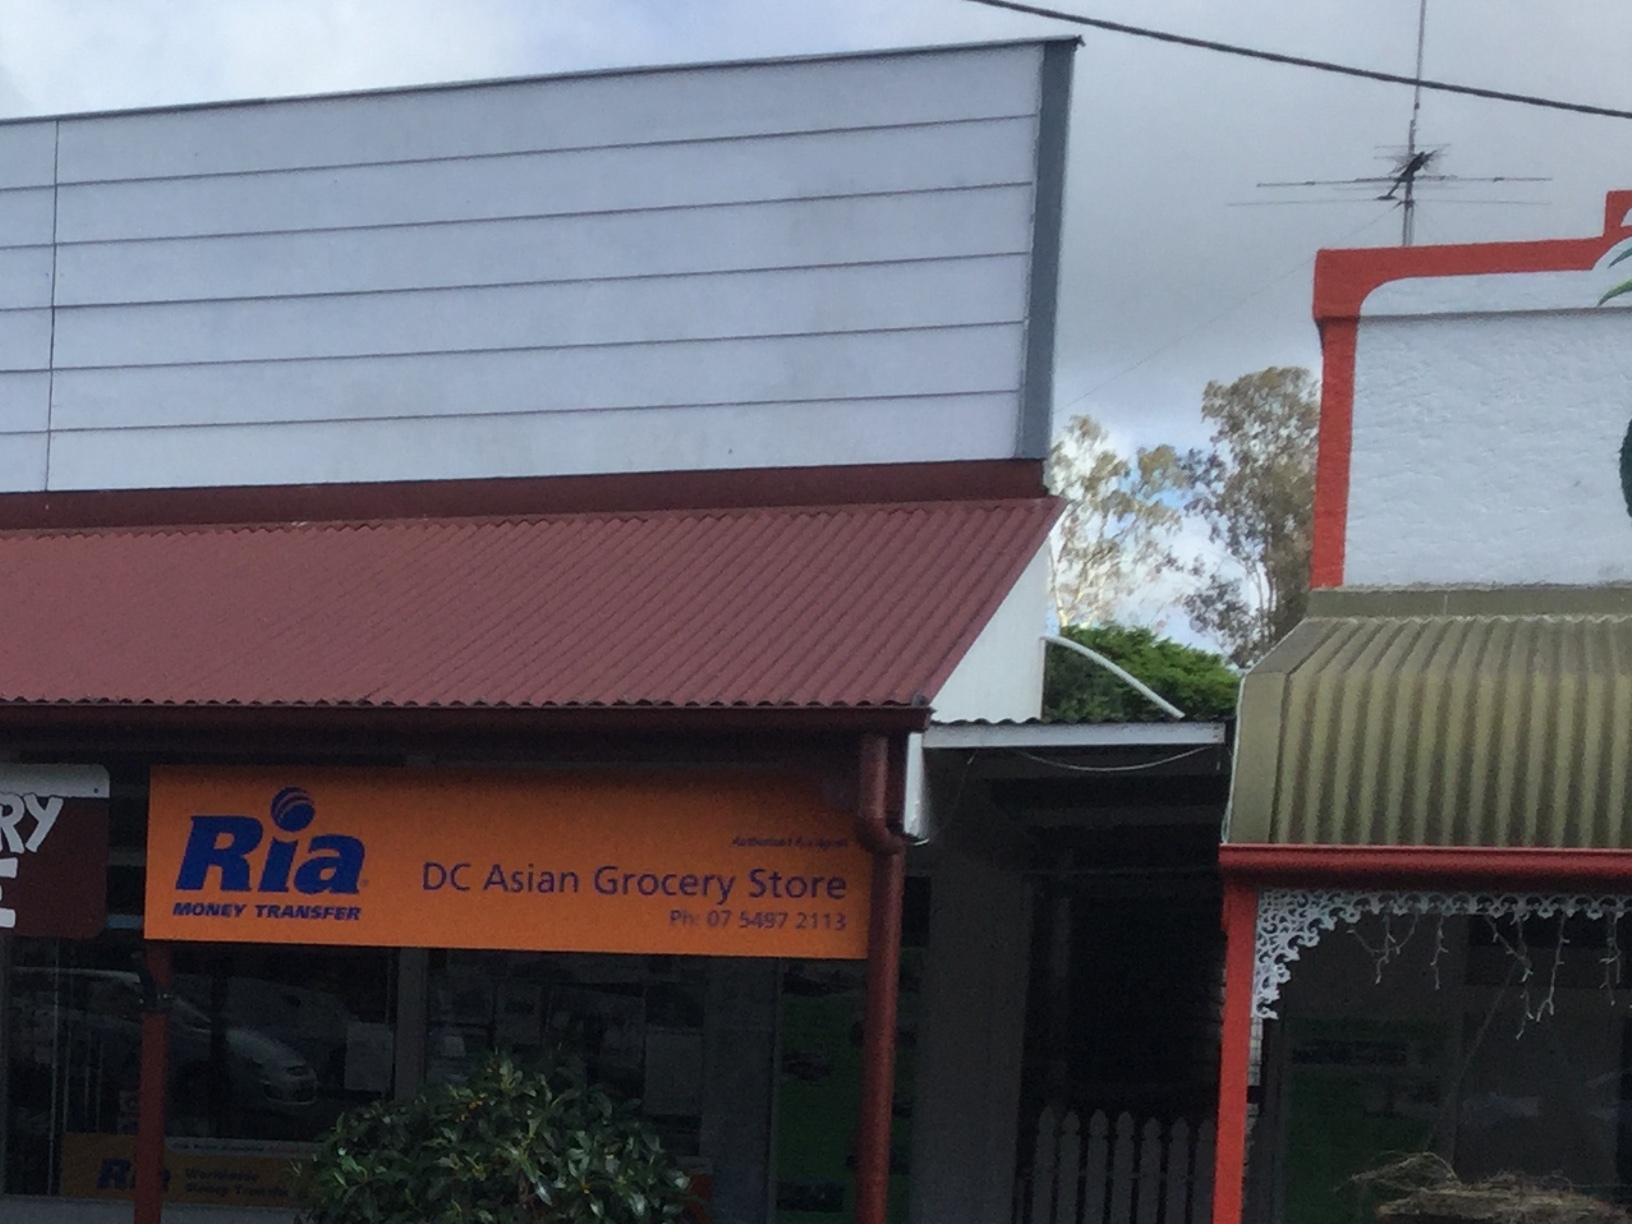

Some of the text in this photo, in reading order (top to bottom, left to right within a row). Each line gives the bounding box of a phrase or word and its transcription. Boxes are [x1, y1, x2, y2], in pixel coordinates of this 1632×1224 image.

[176, 787, 365, 894] Ria
[422, 862, 848, 905] DC Asian Grocery Store
[173, 902, 362, 921] MONEY TRANSFER
[706, 909, 733, 928] 07
[795, 911, 848, 931] 2113
